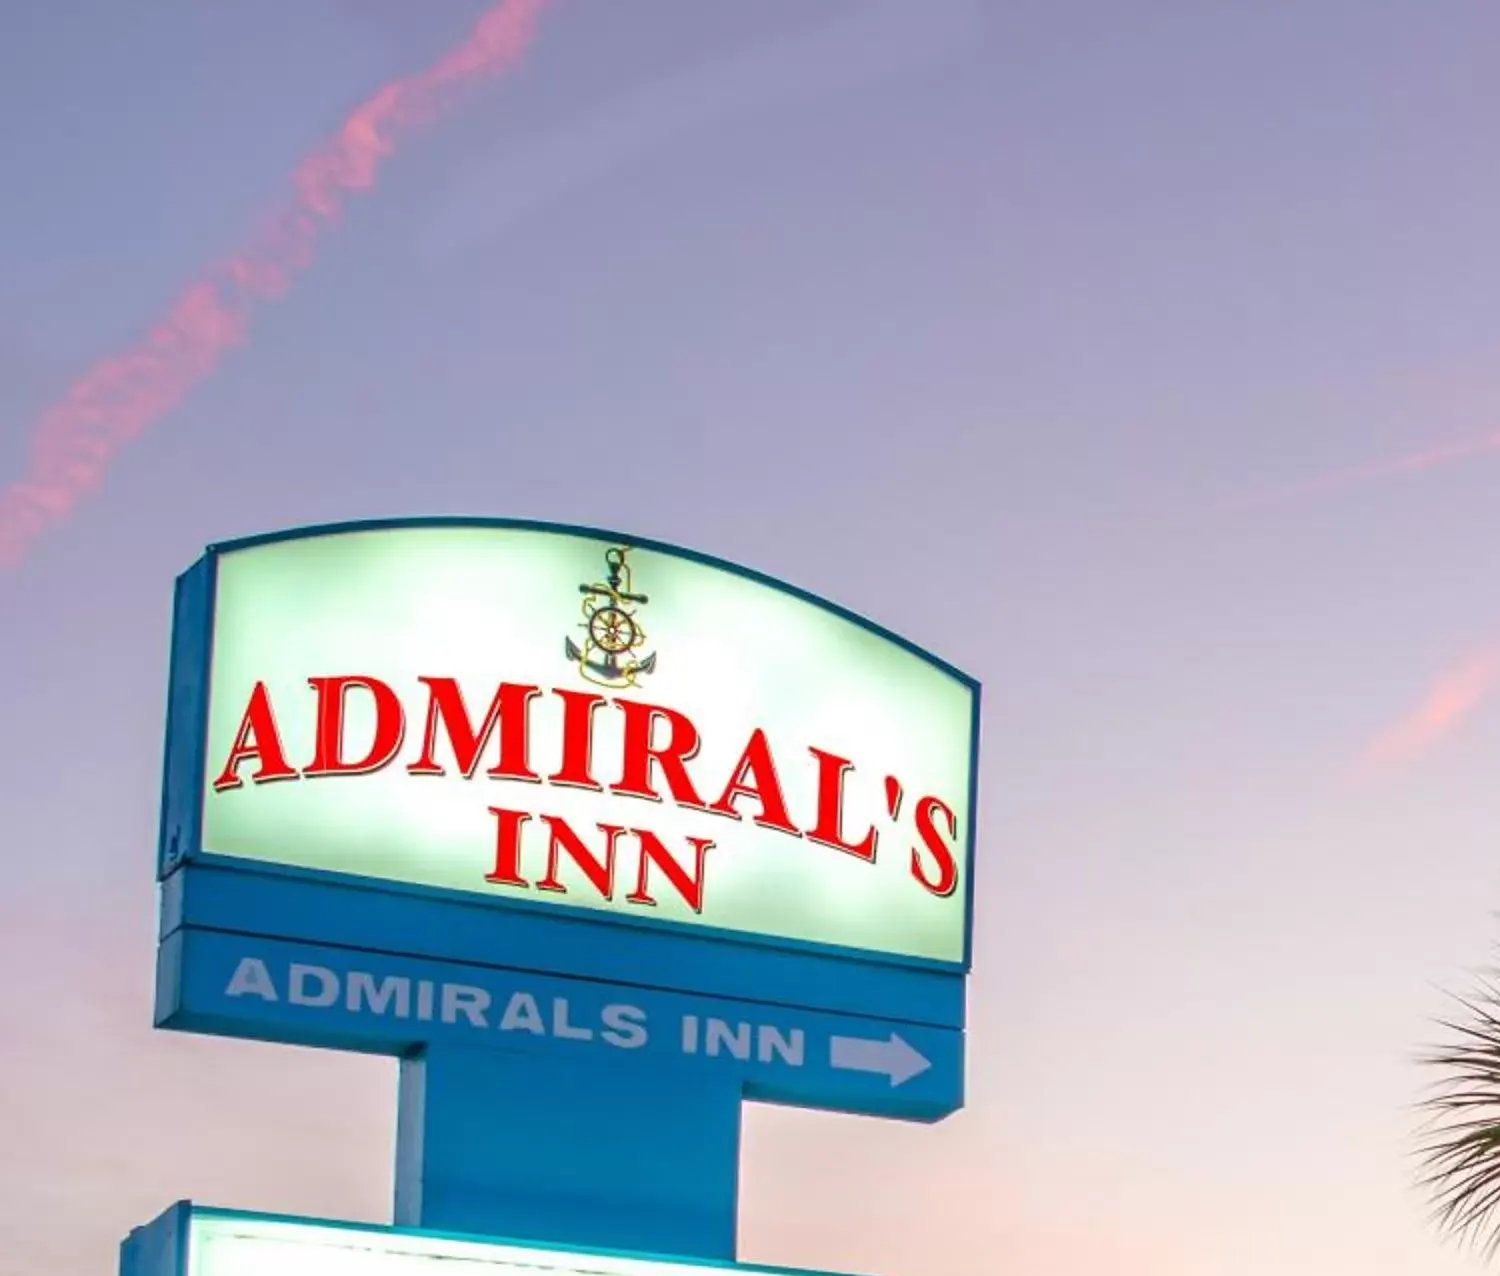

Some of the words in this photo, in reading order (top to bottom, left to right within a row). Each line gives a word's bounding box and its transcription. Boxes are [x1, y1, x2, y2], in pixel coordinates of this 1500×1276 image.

[213, 674, 958, 897] ADMIRAL'S
[486, 806, 714, 912] INN
[226, 958, 649, 1049] ADMIRALS
[682, 1015, 806, 1067] INN
